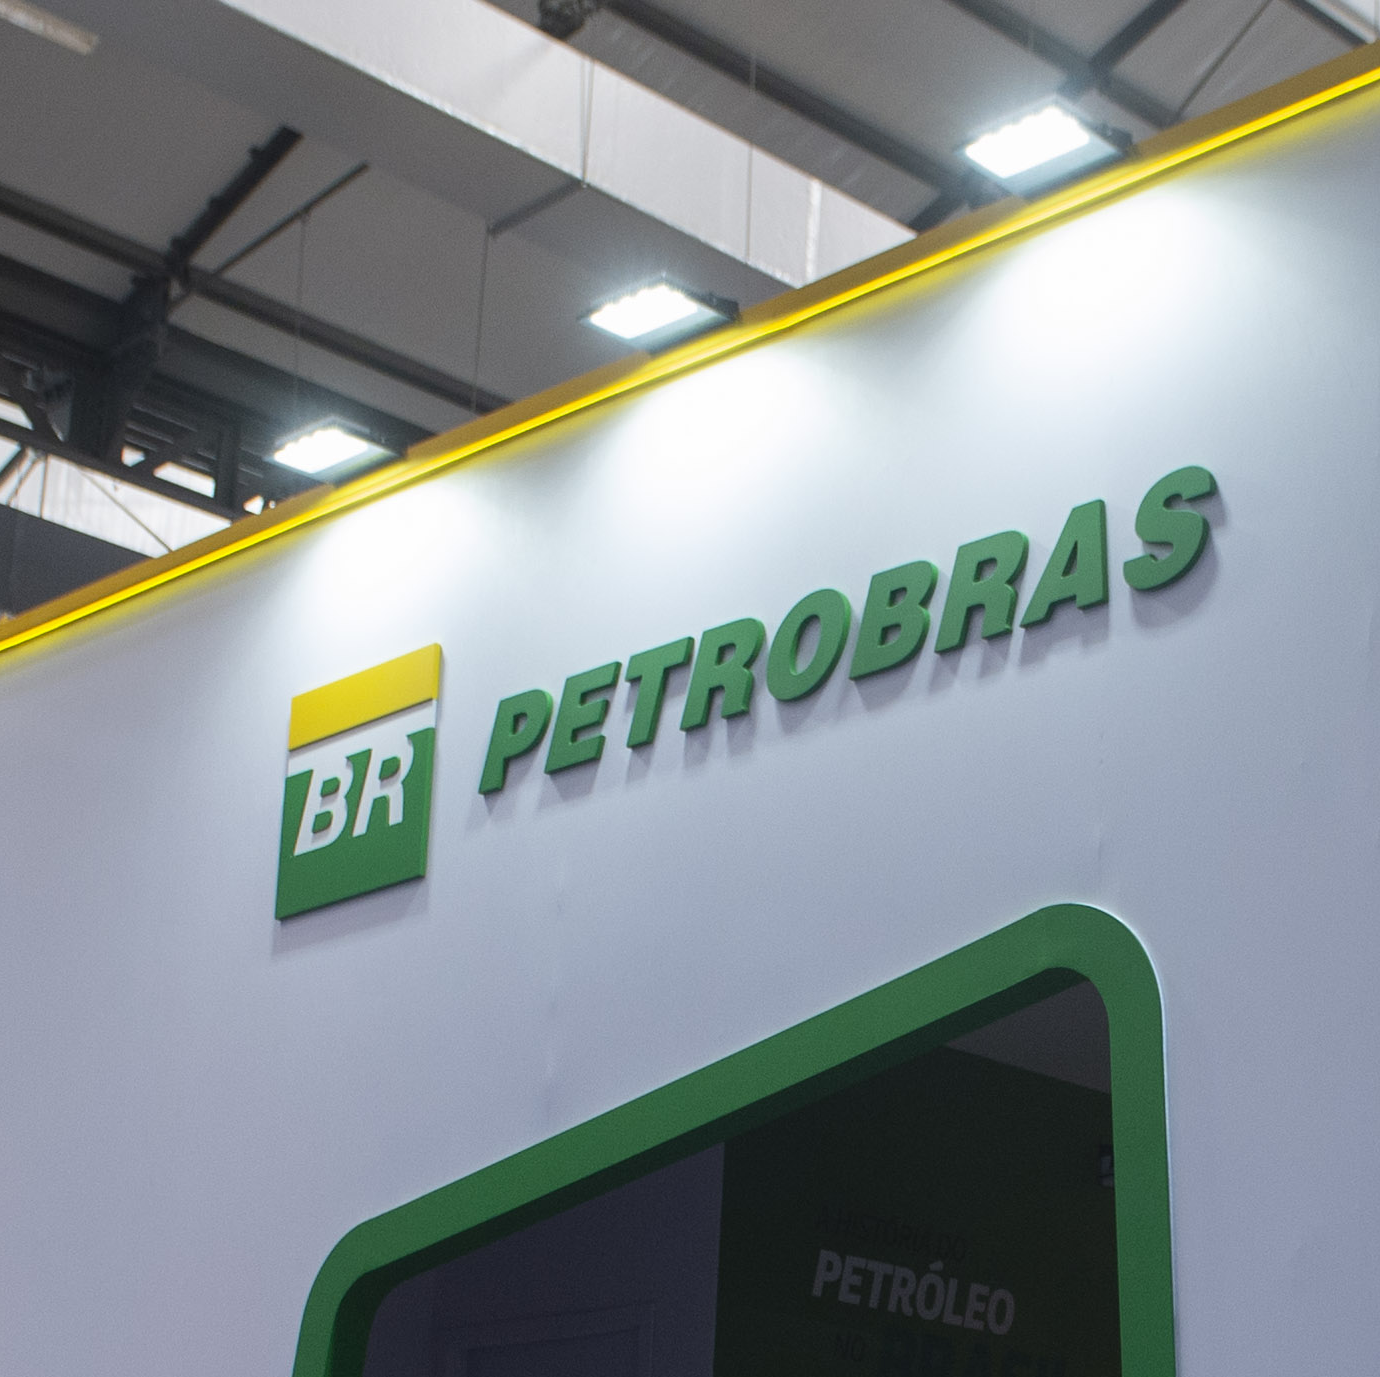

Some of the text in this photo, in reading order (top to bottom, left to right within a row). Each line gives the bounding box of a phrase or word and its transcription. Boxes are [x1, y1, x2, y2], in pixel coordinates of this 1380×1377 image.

[293, 466, 1217, 857] BR PETROBRAS
[812, 1248, 1016, 1336] PETRÓLEO
[834, 1331, 867, 1363] NO
